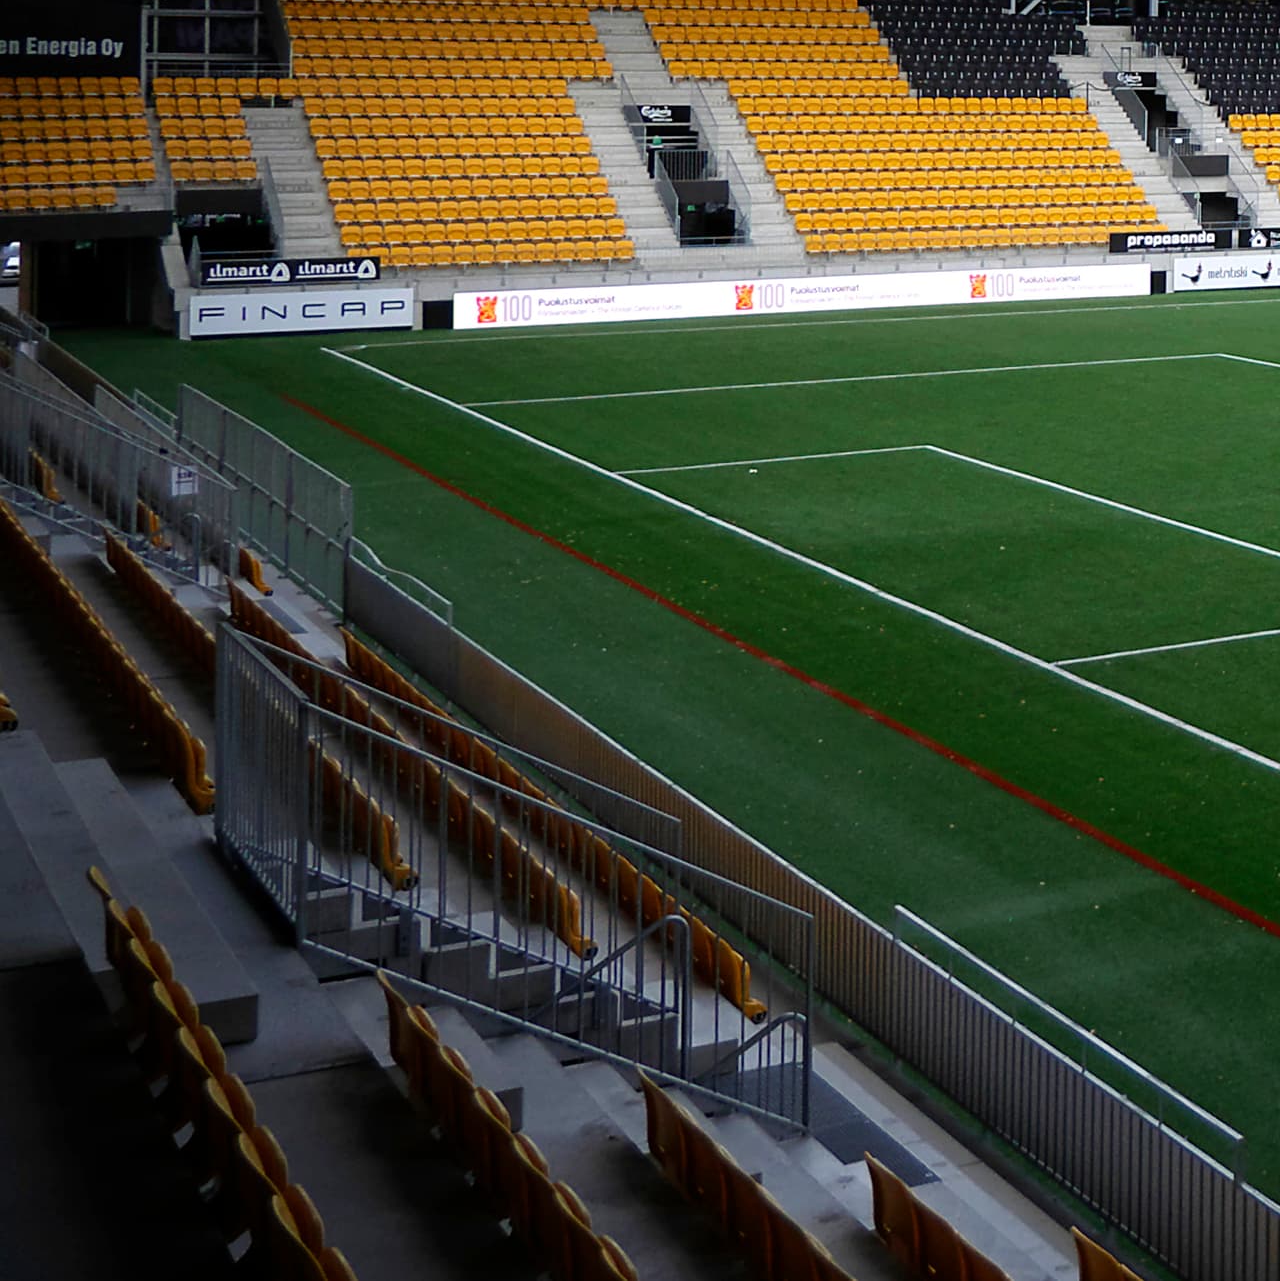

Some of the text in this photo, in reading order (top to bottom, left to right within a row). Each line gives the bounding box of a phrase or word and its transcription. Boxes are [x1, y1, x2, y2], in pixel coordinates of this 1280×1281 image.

[26, 36, 97, 58] Energia
[101, 37, 124, 58] Oy
[502, 294, 532, 322] 100
[758, 283, 785, 309] 100
[199, 300, 407, 322] FINCAP
